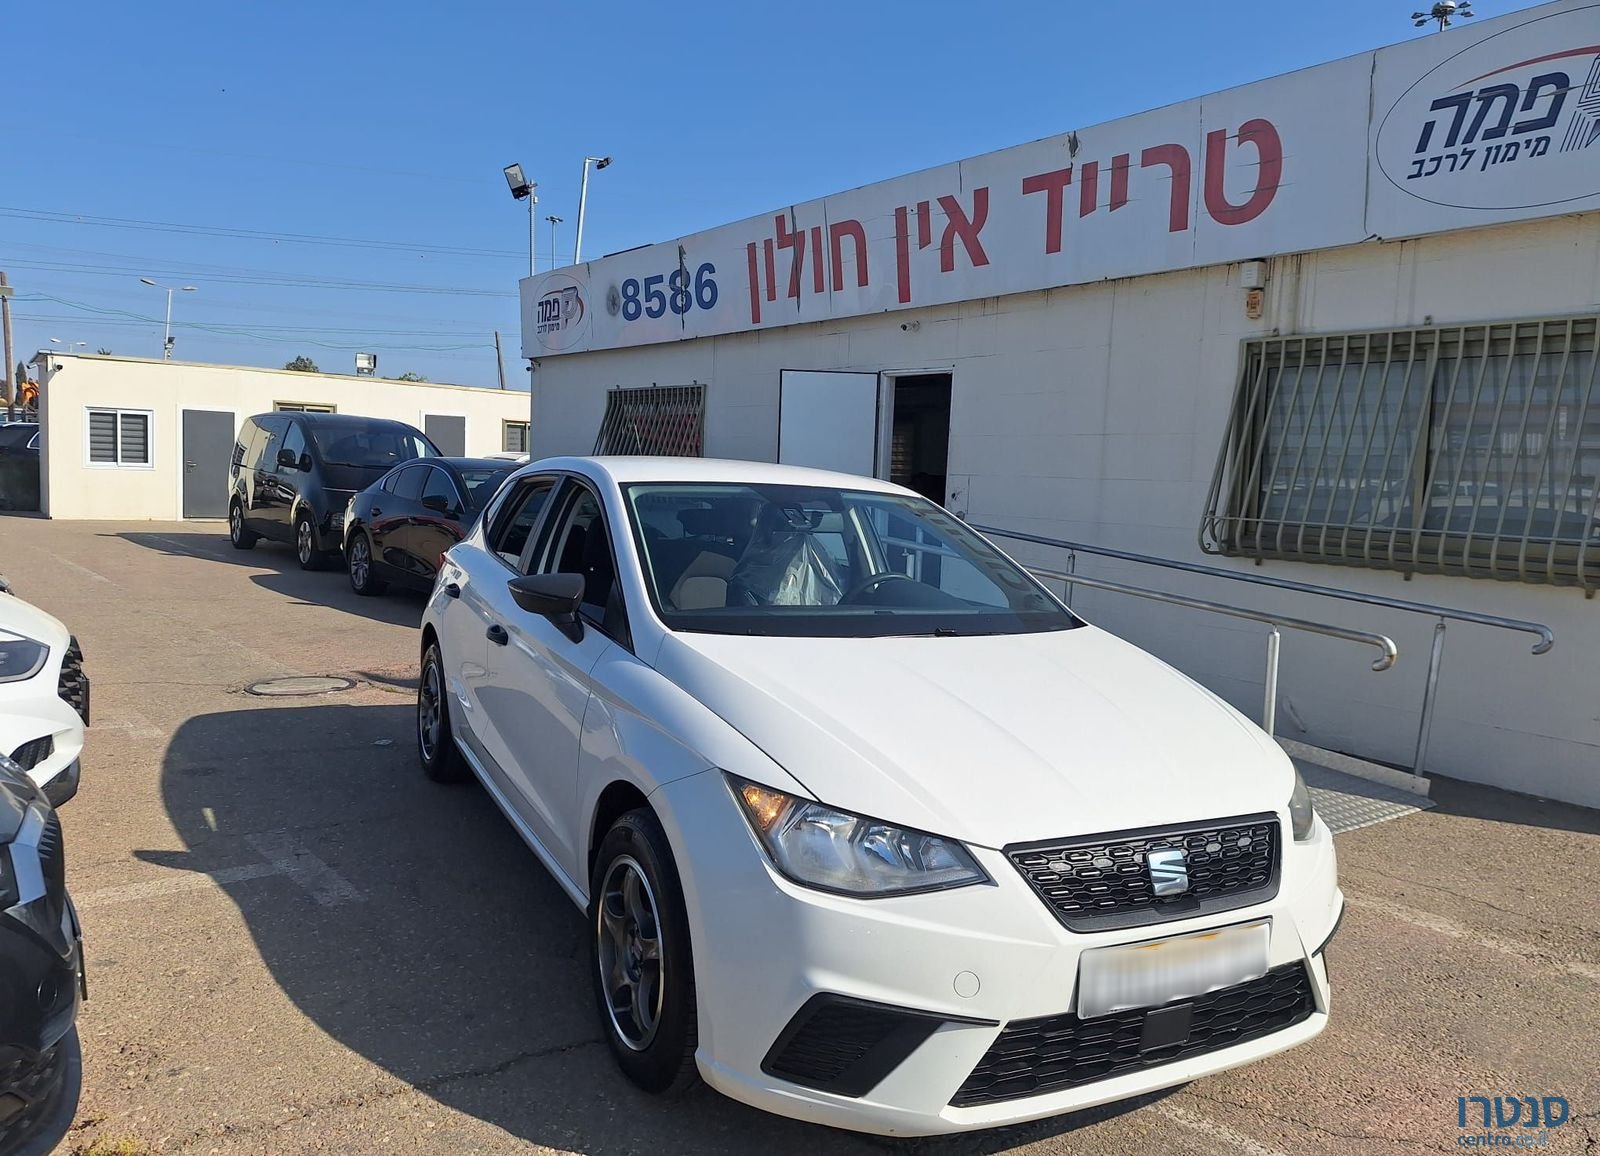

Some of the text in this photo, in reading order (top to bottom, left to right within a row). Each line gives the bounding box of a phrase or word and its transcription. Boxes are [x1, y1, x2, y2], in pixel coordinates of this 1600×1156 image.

[1415, 72, 1570, 154] פמה
[1406, 136, 1551, 180] מימון לרכב
[747, 118, 1283, 324] טרייד אין חולון
[537, 298, 560, 324] פמה
[621, 262, 719, 322] 8586
[547, 323, 560, 335] מימון
